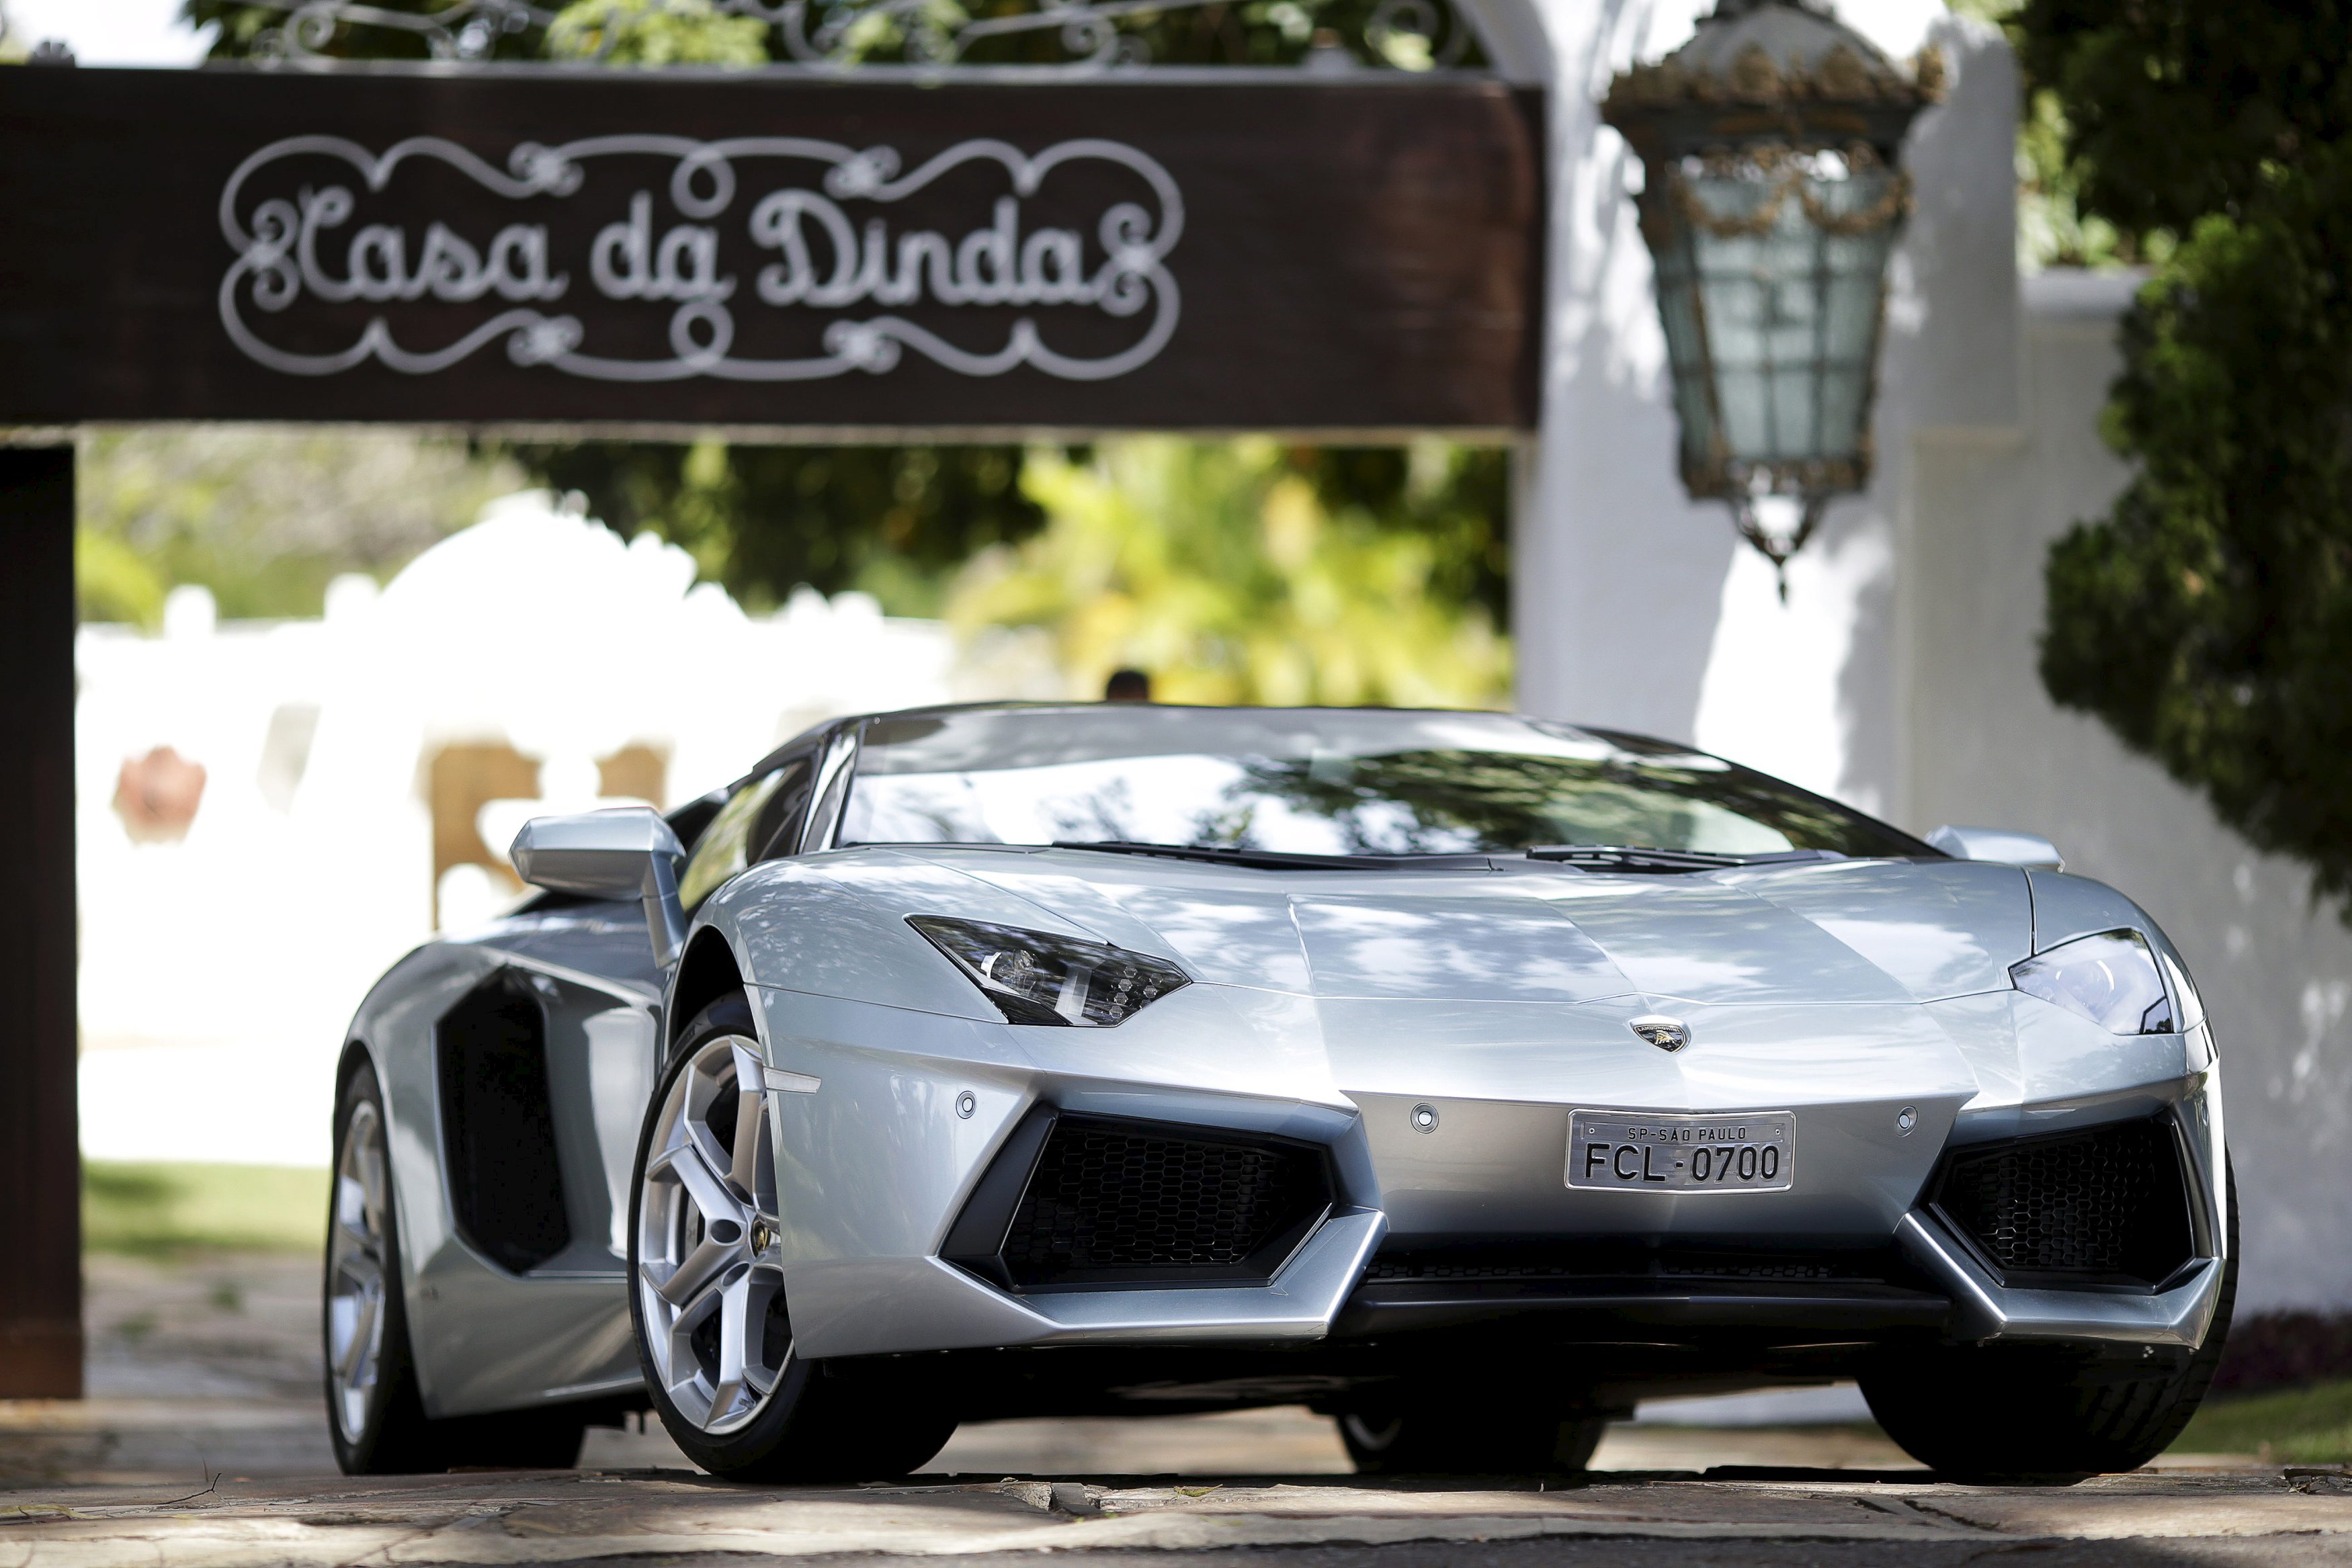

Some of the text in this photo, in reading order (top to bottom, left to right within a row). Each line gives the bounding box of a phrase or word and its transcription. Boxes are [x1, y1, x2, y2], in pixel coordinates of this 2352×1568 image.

[297, 184, 1105, 307] Casa da Dinda
[1699, 1127, 1746, 1141] PAULO
[1585, 1143, 1779, 1181] FCL-0700
